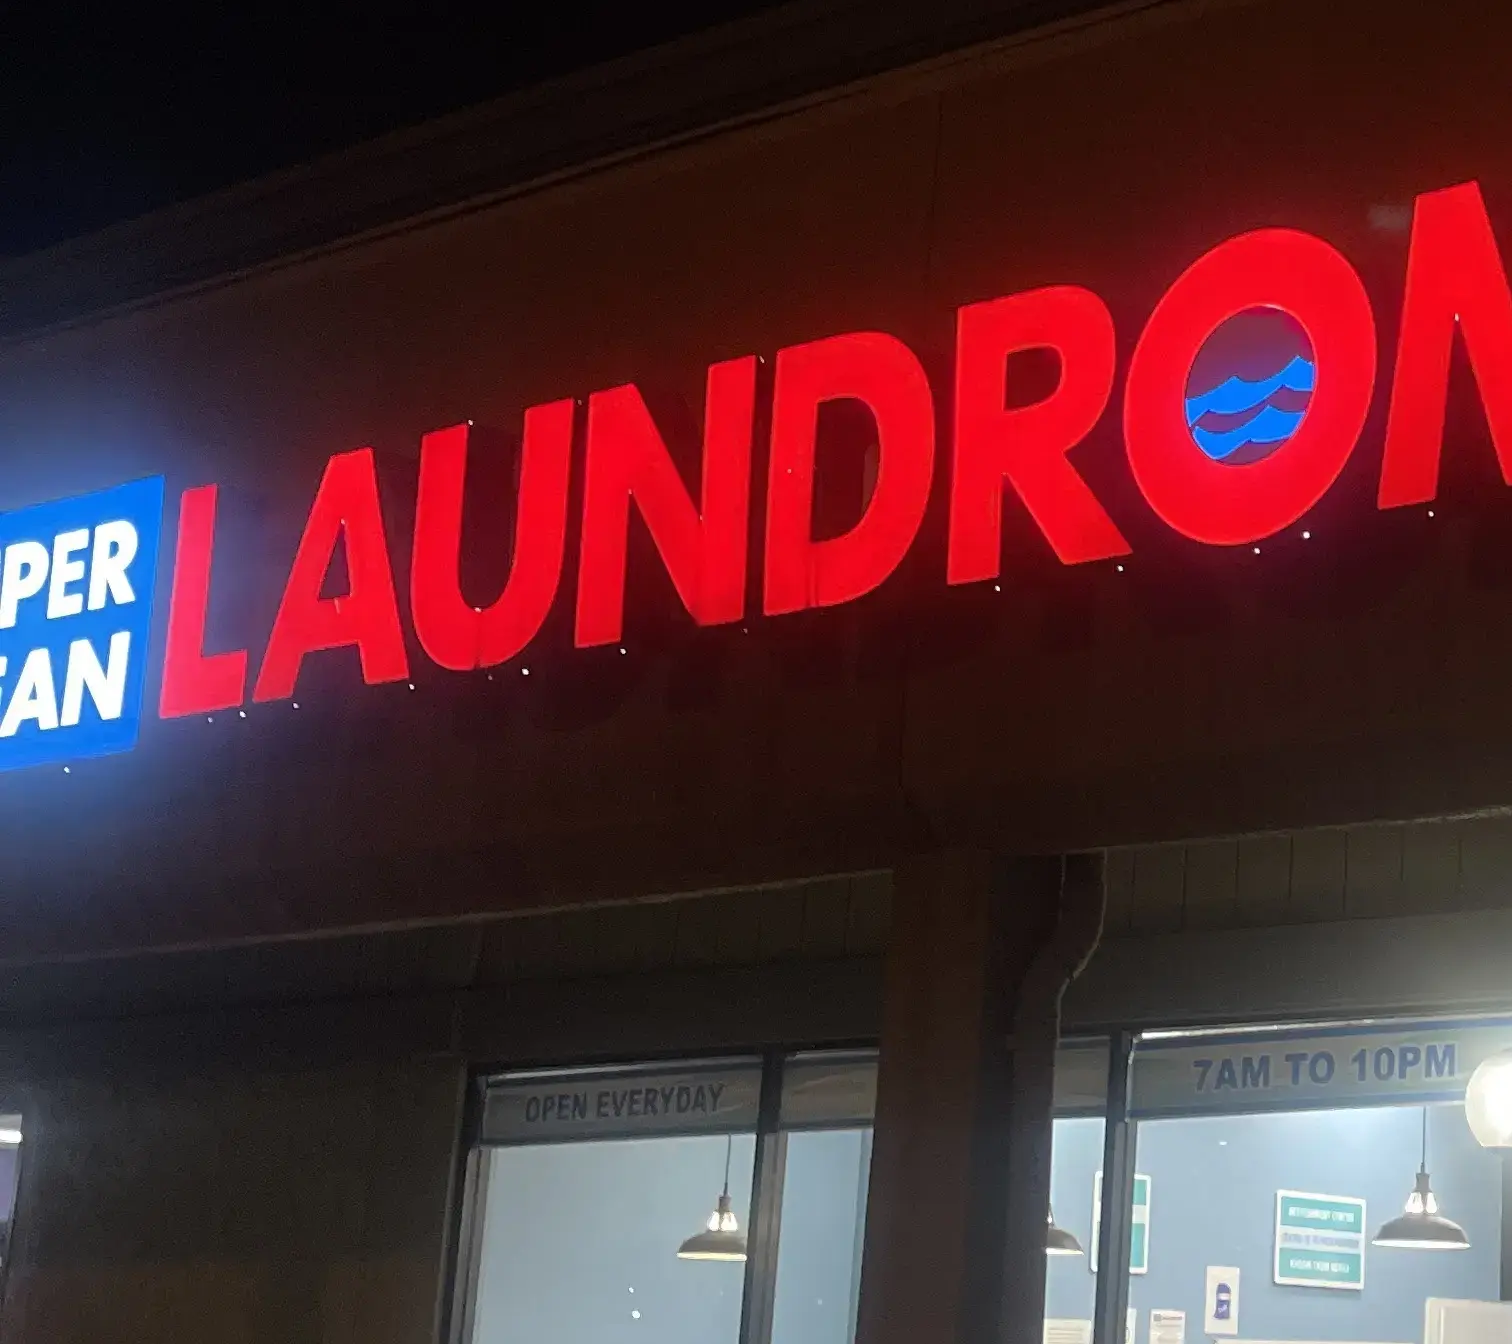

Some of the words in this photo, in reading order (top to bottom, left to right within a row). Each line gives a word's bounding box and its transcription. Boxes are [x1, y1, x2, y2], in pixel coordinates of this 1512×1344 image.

[0, 520, 138, 629] PER
[1193, 1055, 1271, 1091] 7AM
[1286, 1051, 1336, 1085] TO
[1350, 1043, 1456, 1082] 10PM
[525, 1092, 588, 1123] OPEN
[597, 1083, 726, 1118] EVERYDAY
